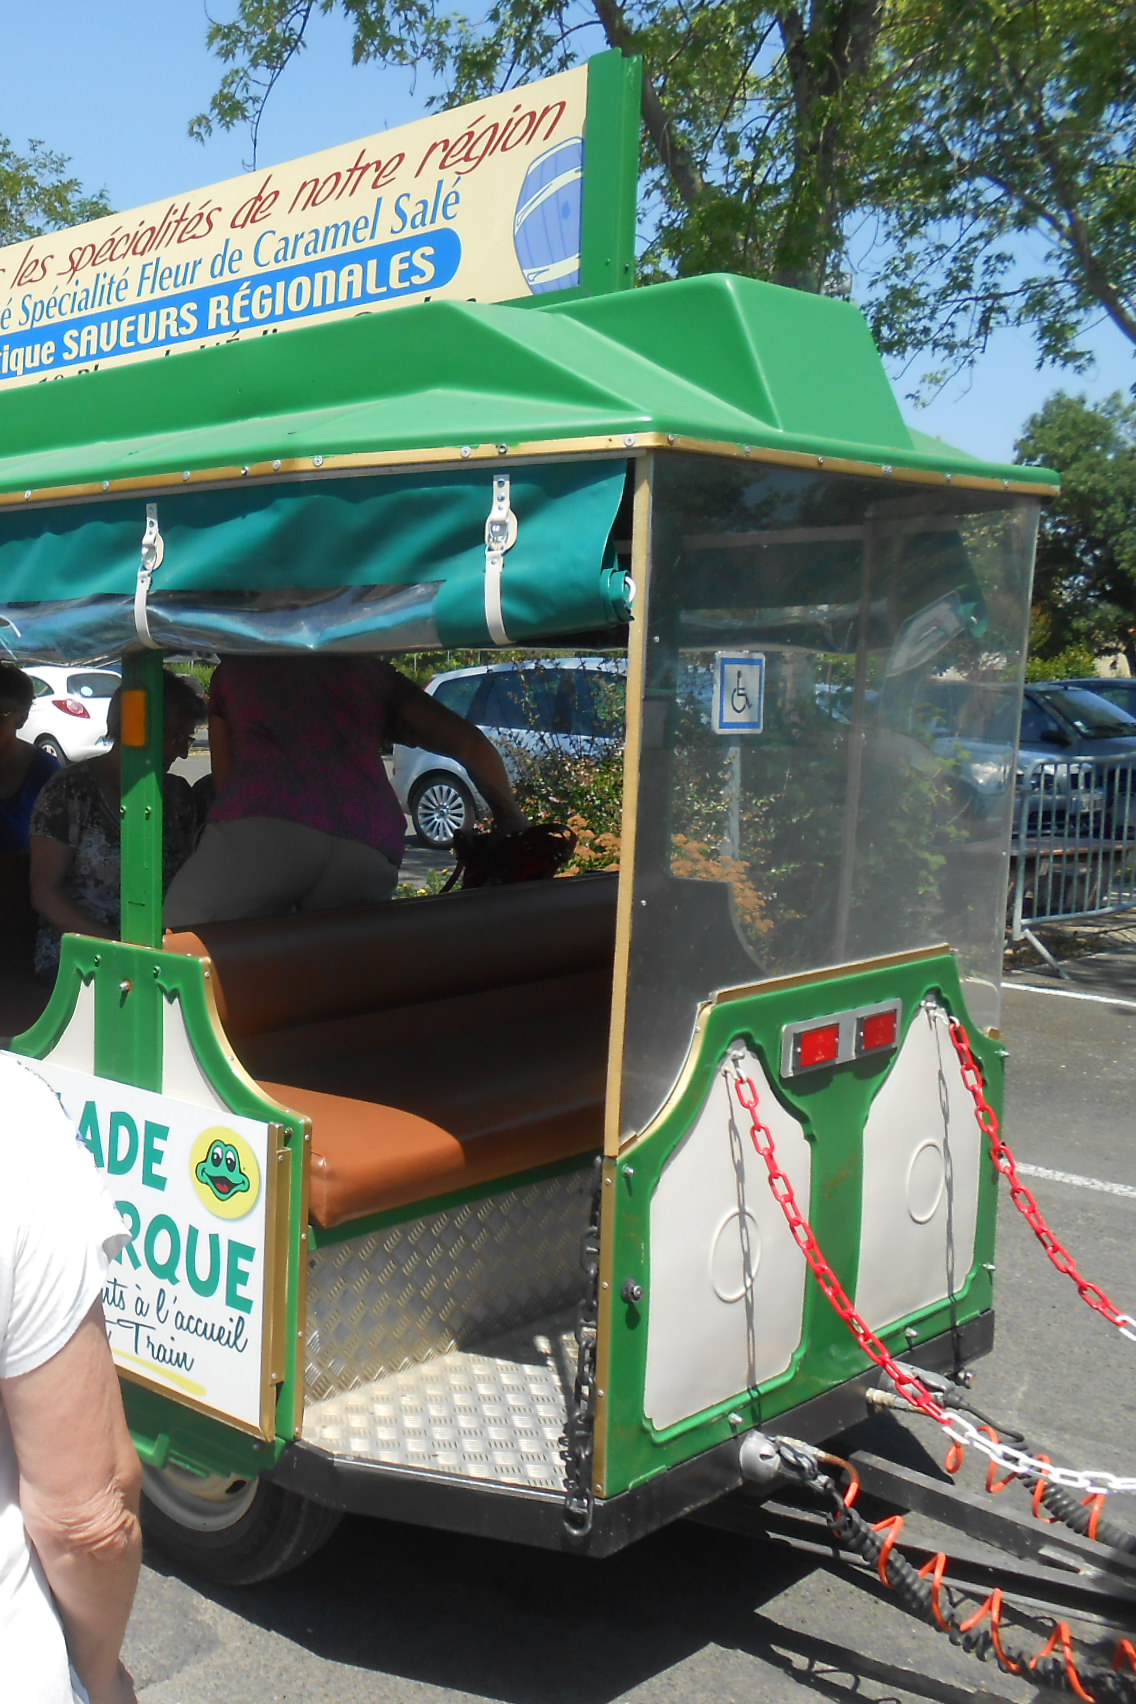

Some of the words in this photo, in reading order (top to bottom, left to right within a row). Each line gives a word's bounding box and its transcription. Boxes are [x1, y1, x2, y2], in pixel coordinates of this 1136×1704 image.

[10, 244, 54, 290] les
[57, 199, 223, 285] spécialités
[230, 174, 280, 229] de
[288, 148, 406, 214] notre
[414, 100, 567, 179] région
[18, 266, 129, 329] Spécialité
[136, 256, 202, 297] Fleur
[210, 238, 243, 279] de
[254, 197, 383, 267] Caramel
[390, 176, 461, 234] Salé
[62, 301, 198, 359] SAVEURS
[207, 245, 435, 329] RÉGIONALES
[77, 1101, 170, 1192] ADE
[114, 1200, 256, 1315] RQUE
[102, 1278, 128, 1311] nts
[135, 1283, 150, 1317] à
[157, 1288, 248, 1353] l'accueil
[116, 1318, 194, 1371] Train
